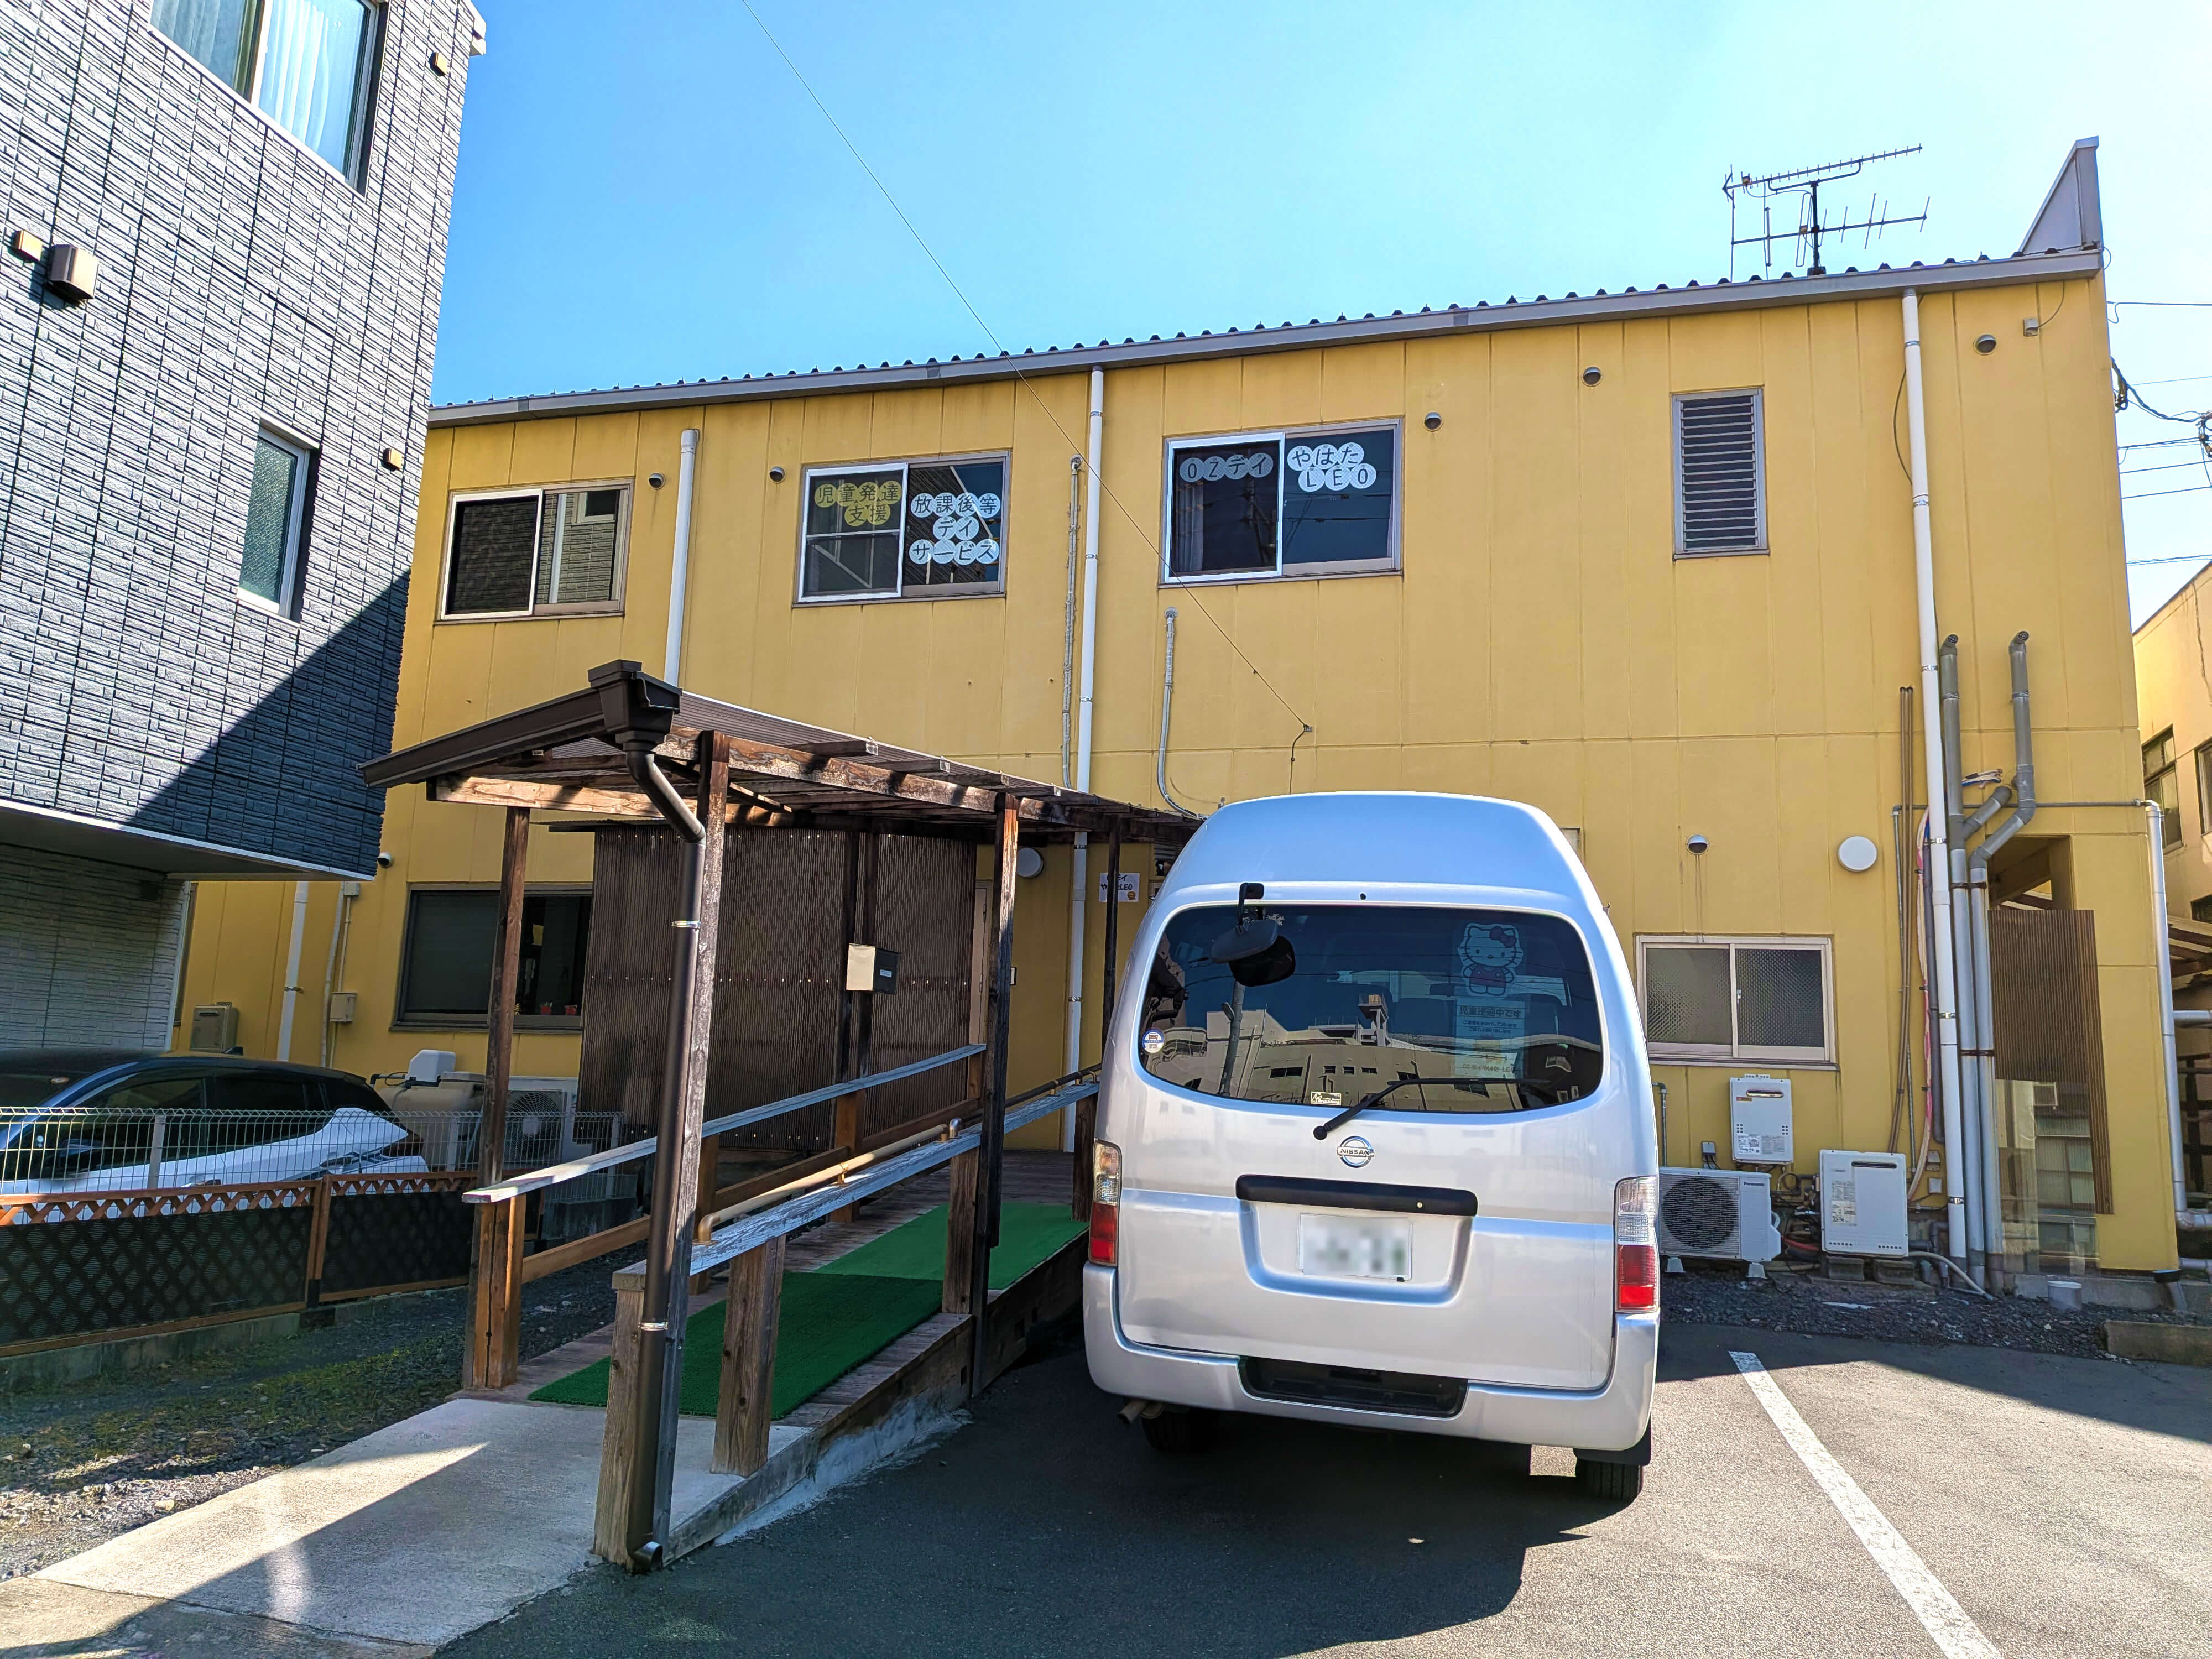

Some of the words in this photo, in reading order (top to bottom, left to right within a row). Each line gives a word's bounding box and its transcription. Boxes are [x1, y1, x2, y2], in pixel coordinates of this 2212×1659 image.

[1292, 446, 1359, 466] やはた
[1187, 456, 1268, 479] OZデイ
[1306, 468, 1368, 488] LEO
[818, 482, 899, 503] 児童発達
[848, 504, 888, 524] 支援
[914, 495, 998, 514] 放課後等
[938, 519, 973, 538] デイ
[912, 542, 995, 561] サービス
